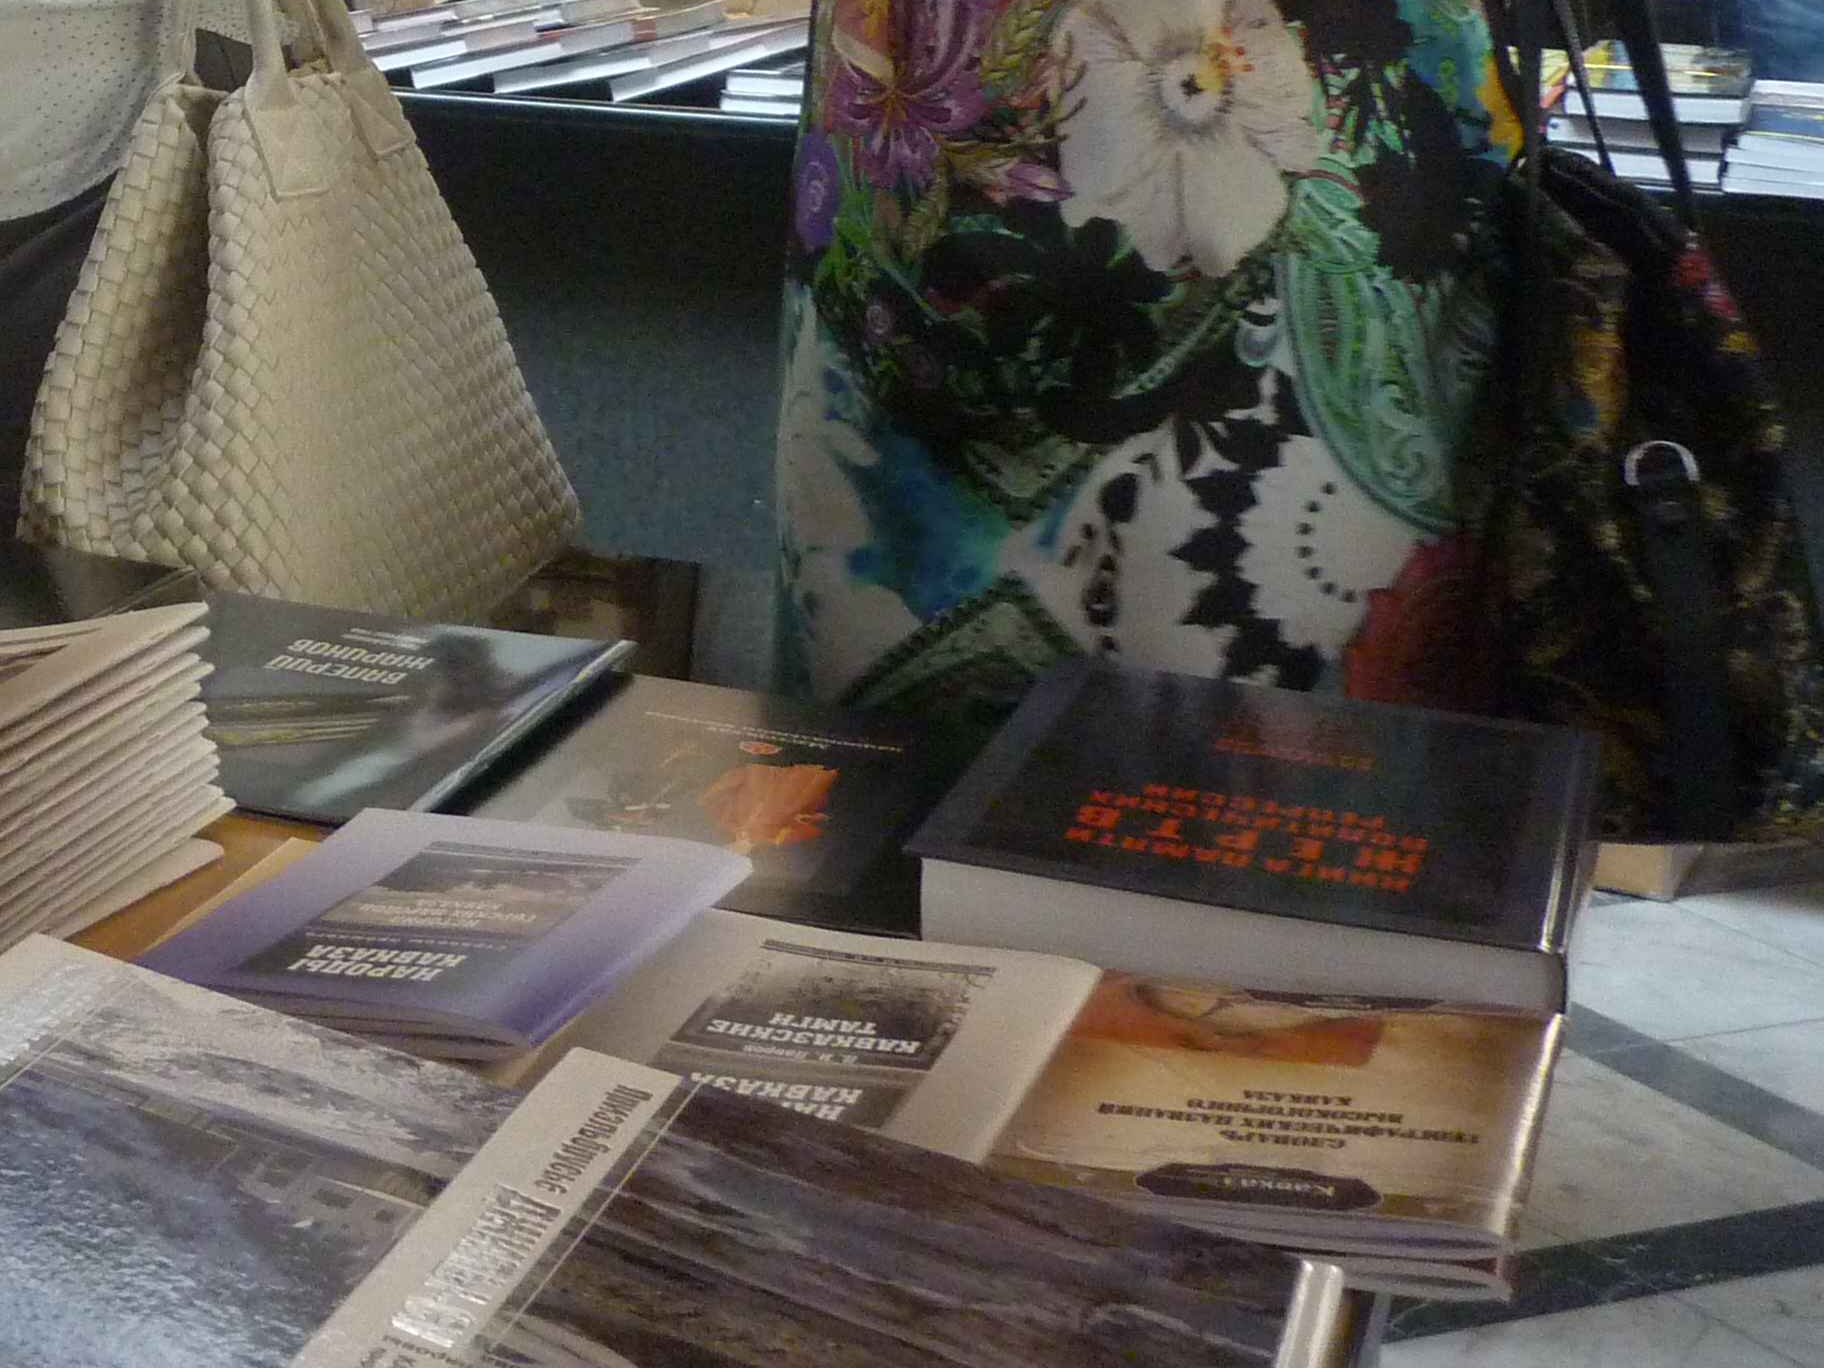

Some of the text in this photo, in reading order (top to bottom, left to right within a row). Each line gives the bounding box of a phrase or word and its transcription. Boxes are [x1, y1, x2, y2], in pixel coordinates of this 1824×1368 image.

[286, 637, 436, 671] ЖАРИНОВ
[262, 653, 408, 685] ВАЛЕРИЙ
[286, 957, 444, 982] НАРОДЫ
[304, 943, 468, 969] КАВКАЗА
[704, 1018, 923, 1055] КАВКАЗСКИЕ
[768, 1012, 878, 1036] ТАМГИ
[1185, 1097, 1404, 1125] ВЫСОКОГОРНОГО
[1243, 1088, 1353, 1108] КАВКАЗА
[1096, 1101, 1480, 1145] ГЕОГРАФИЧЕСКИХ НАЗВАНИЙ
[535, 1083, 654, 1196] Приэльбрусье
[1219, 1129, 1347, 1150] СЛОВАРЬ
